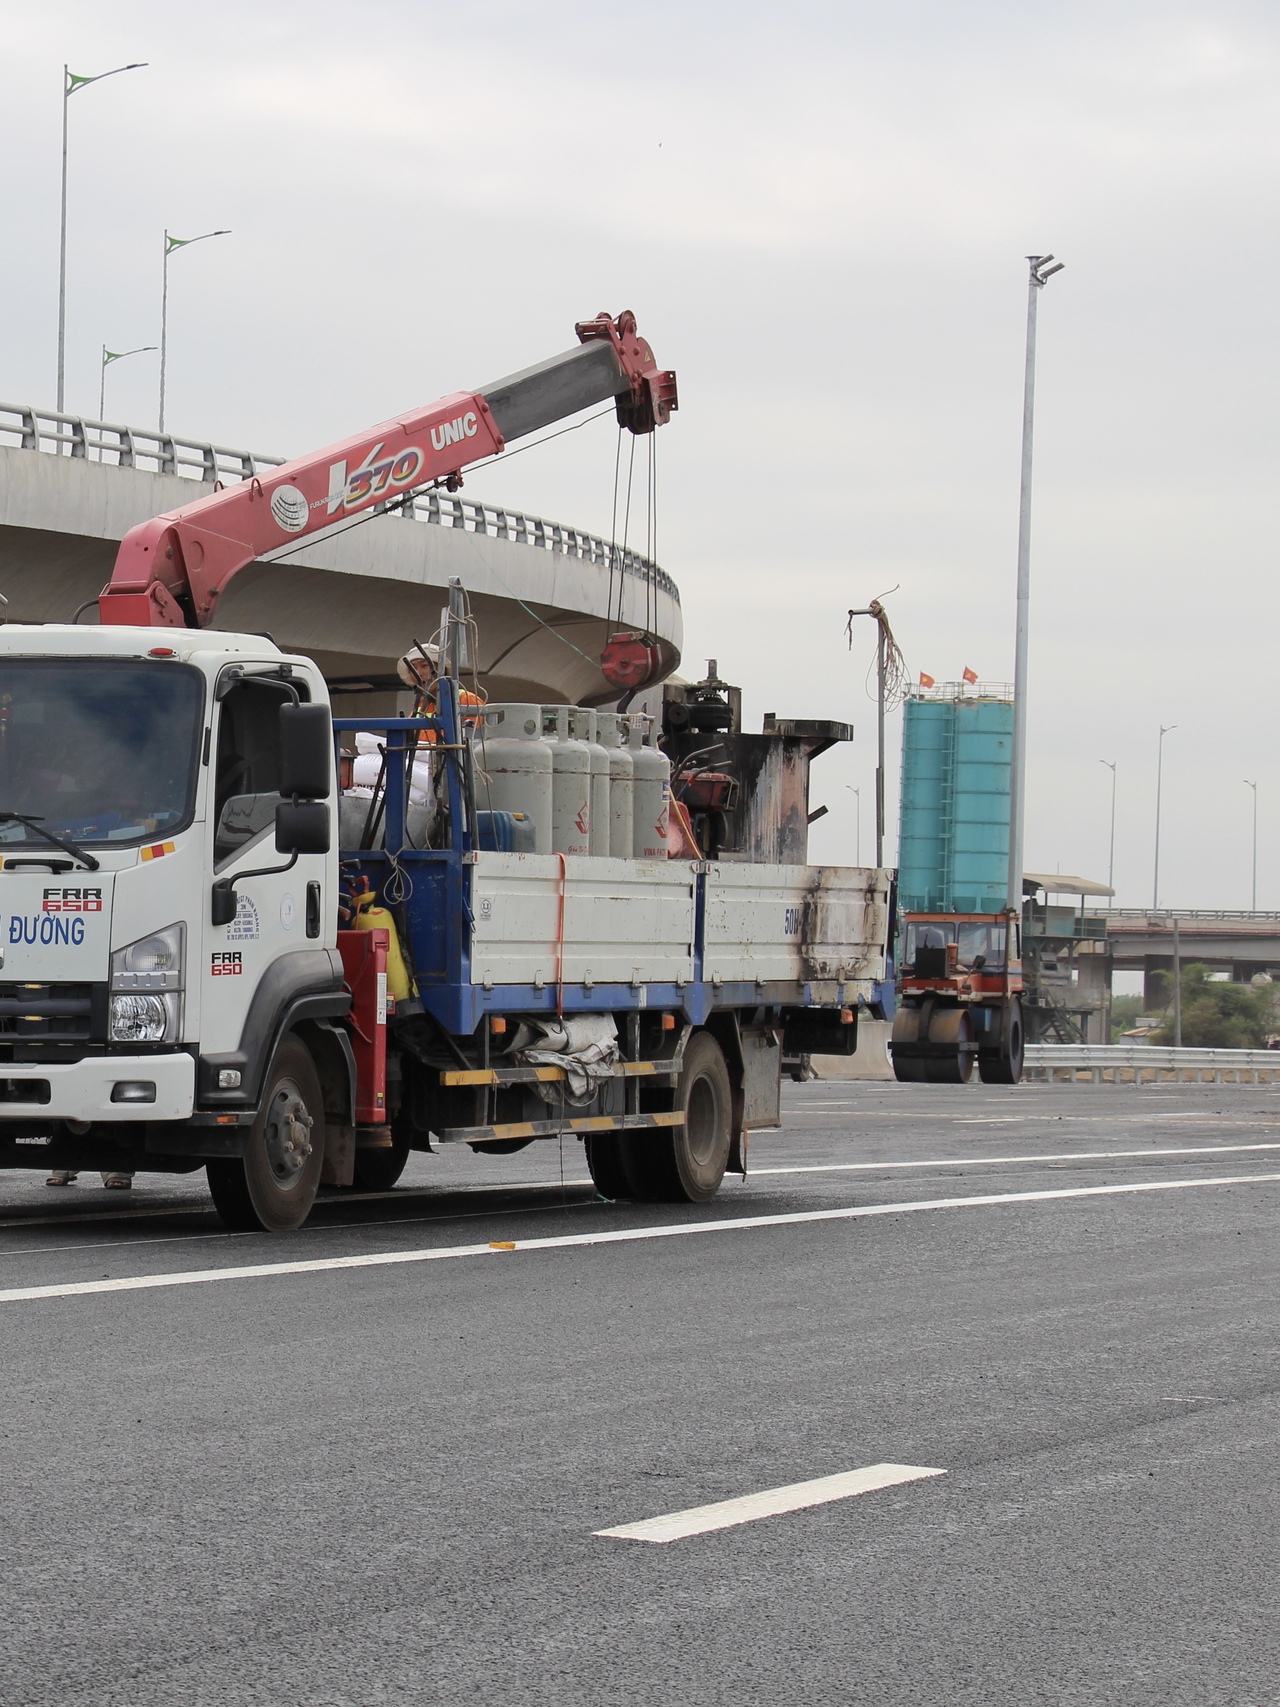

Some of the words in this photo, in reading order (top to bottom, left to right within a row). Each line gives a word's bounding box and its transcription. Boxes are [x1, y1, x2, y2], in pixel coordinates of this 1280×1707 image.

[430, 411, 478, 451] UNIC
[43, 888, 102, 900] FRR
[42, 900, 102, 912] 650
[9, 910, 85, 946] ĐƯỜNG
[211, 951, 242, 964] FRR
[211, 963, 242, 976] 650
